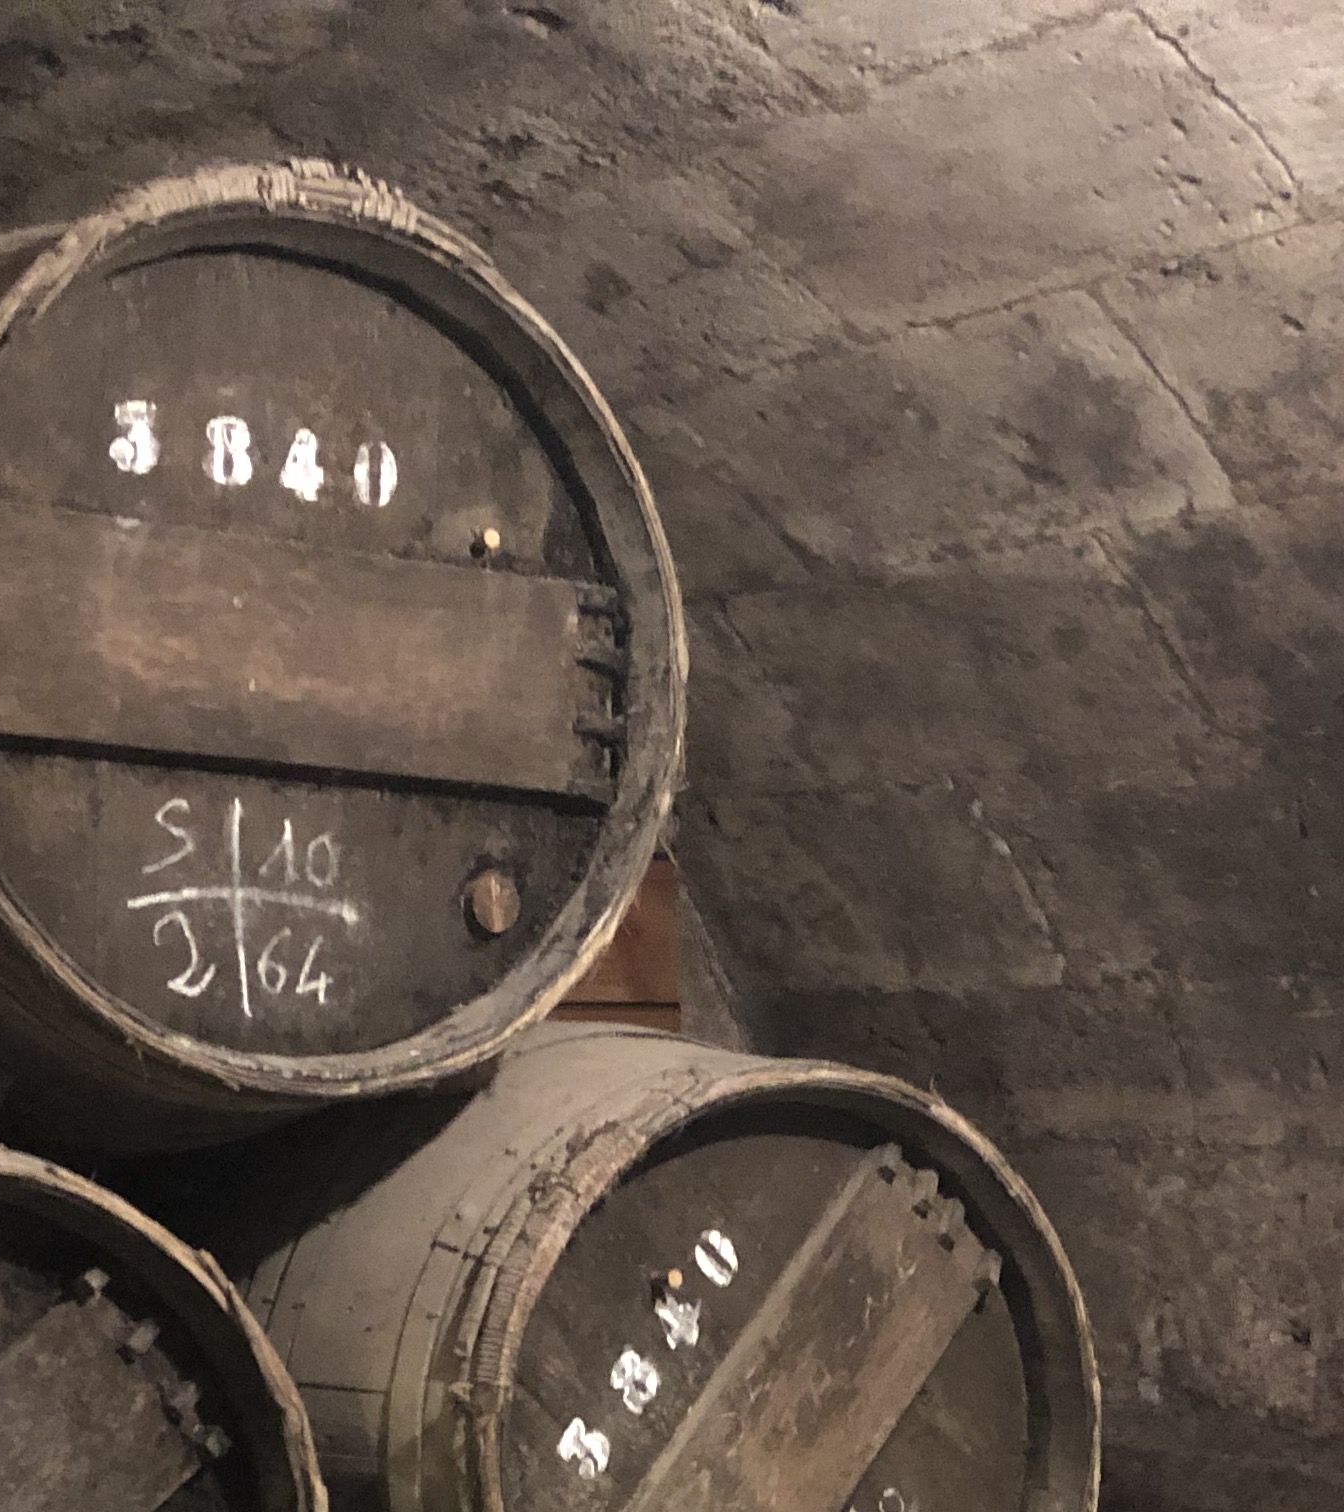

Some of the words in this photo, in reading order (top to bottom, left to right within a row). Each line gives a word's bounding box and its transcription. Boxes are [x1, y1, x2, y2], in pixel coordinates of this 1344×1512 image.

[258, 817, 340, 888] 10
[153, 909, 216, 998] 2
[257, 926, 335, 1005] 64
